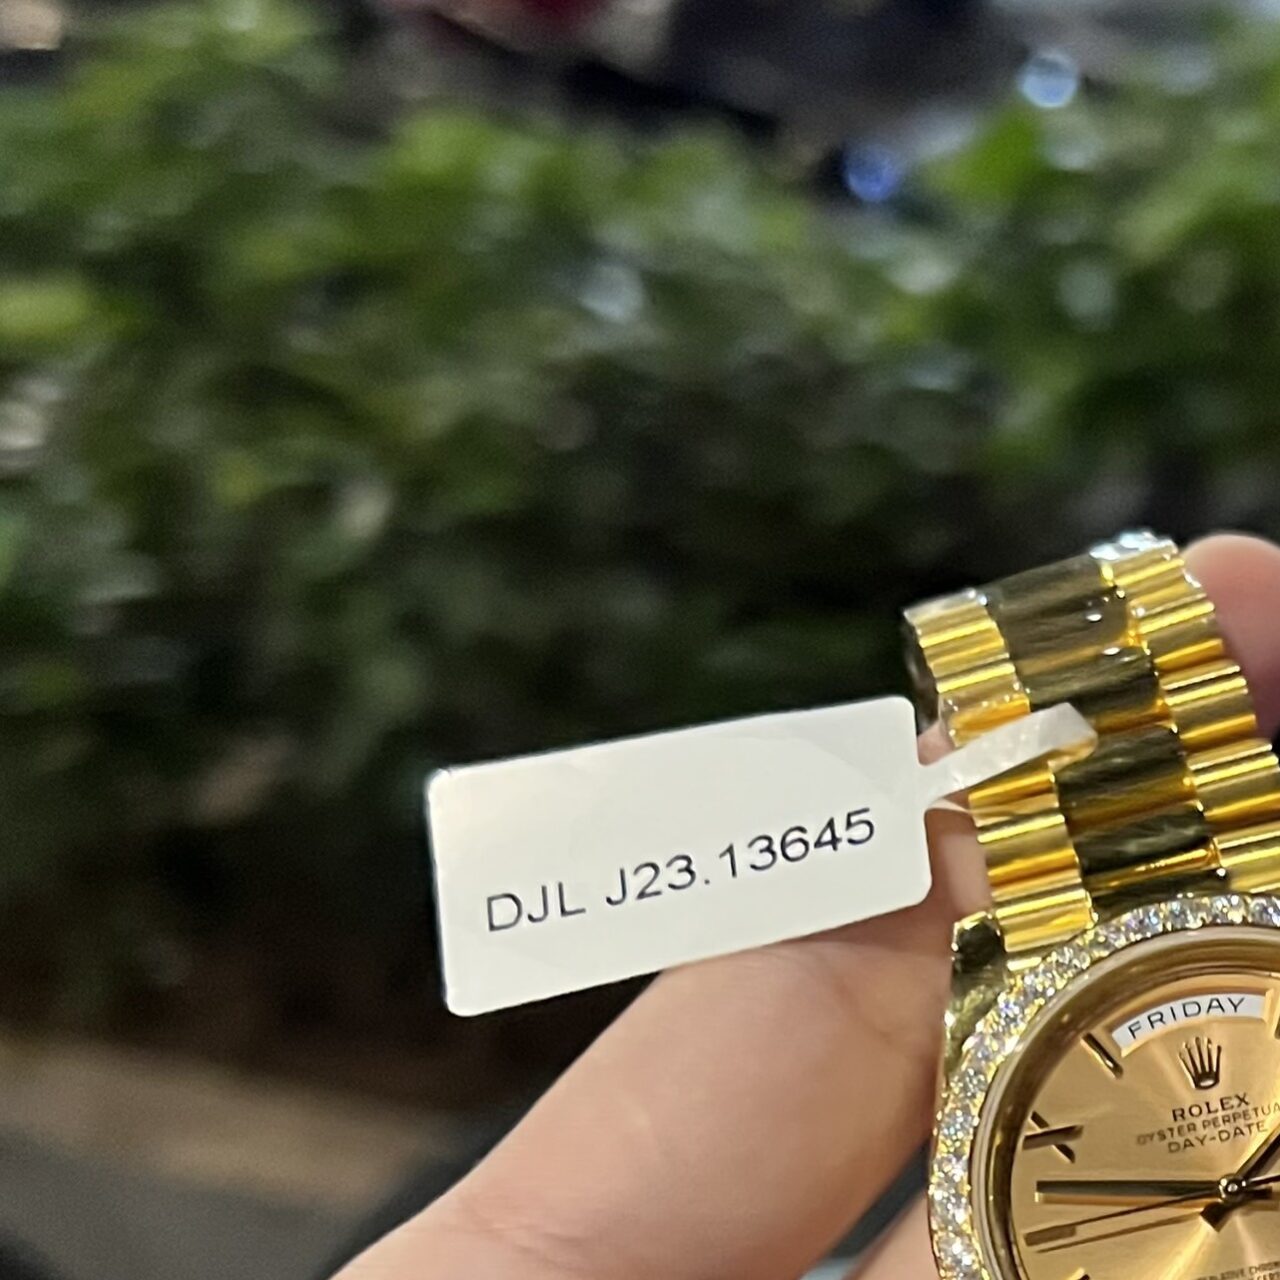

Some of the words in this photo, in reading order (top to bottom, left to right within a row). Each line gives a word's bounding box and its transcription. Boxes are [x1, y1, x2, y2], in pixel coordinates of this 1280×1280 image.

[486, 881, 587, 932] DJL
[605, 807, 875, 908] J23.13645
[1127, 997, 1245, 1039] FRIDAY
[1172, 1092, 1251, 1122] ROLEX
[1136, 1123, 1197, 1146] OYSTER
[1167, 1121, 1269, 1153] DAY-DATE
